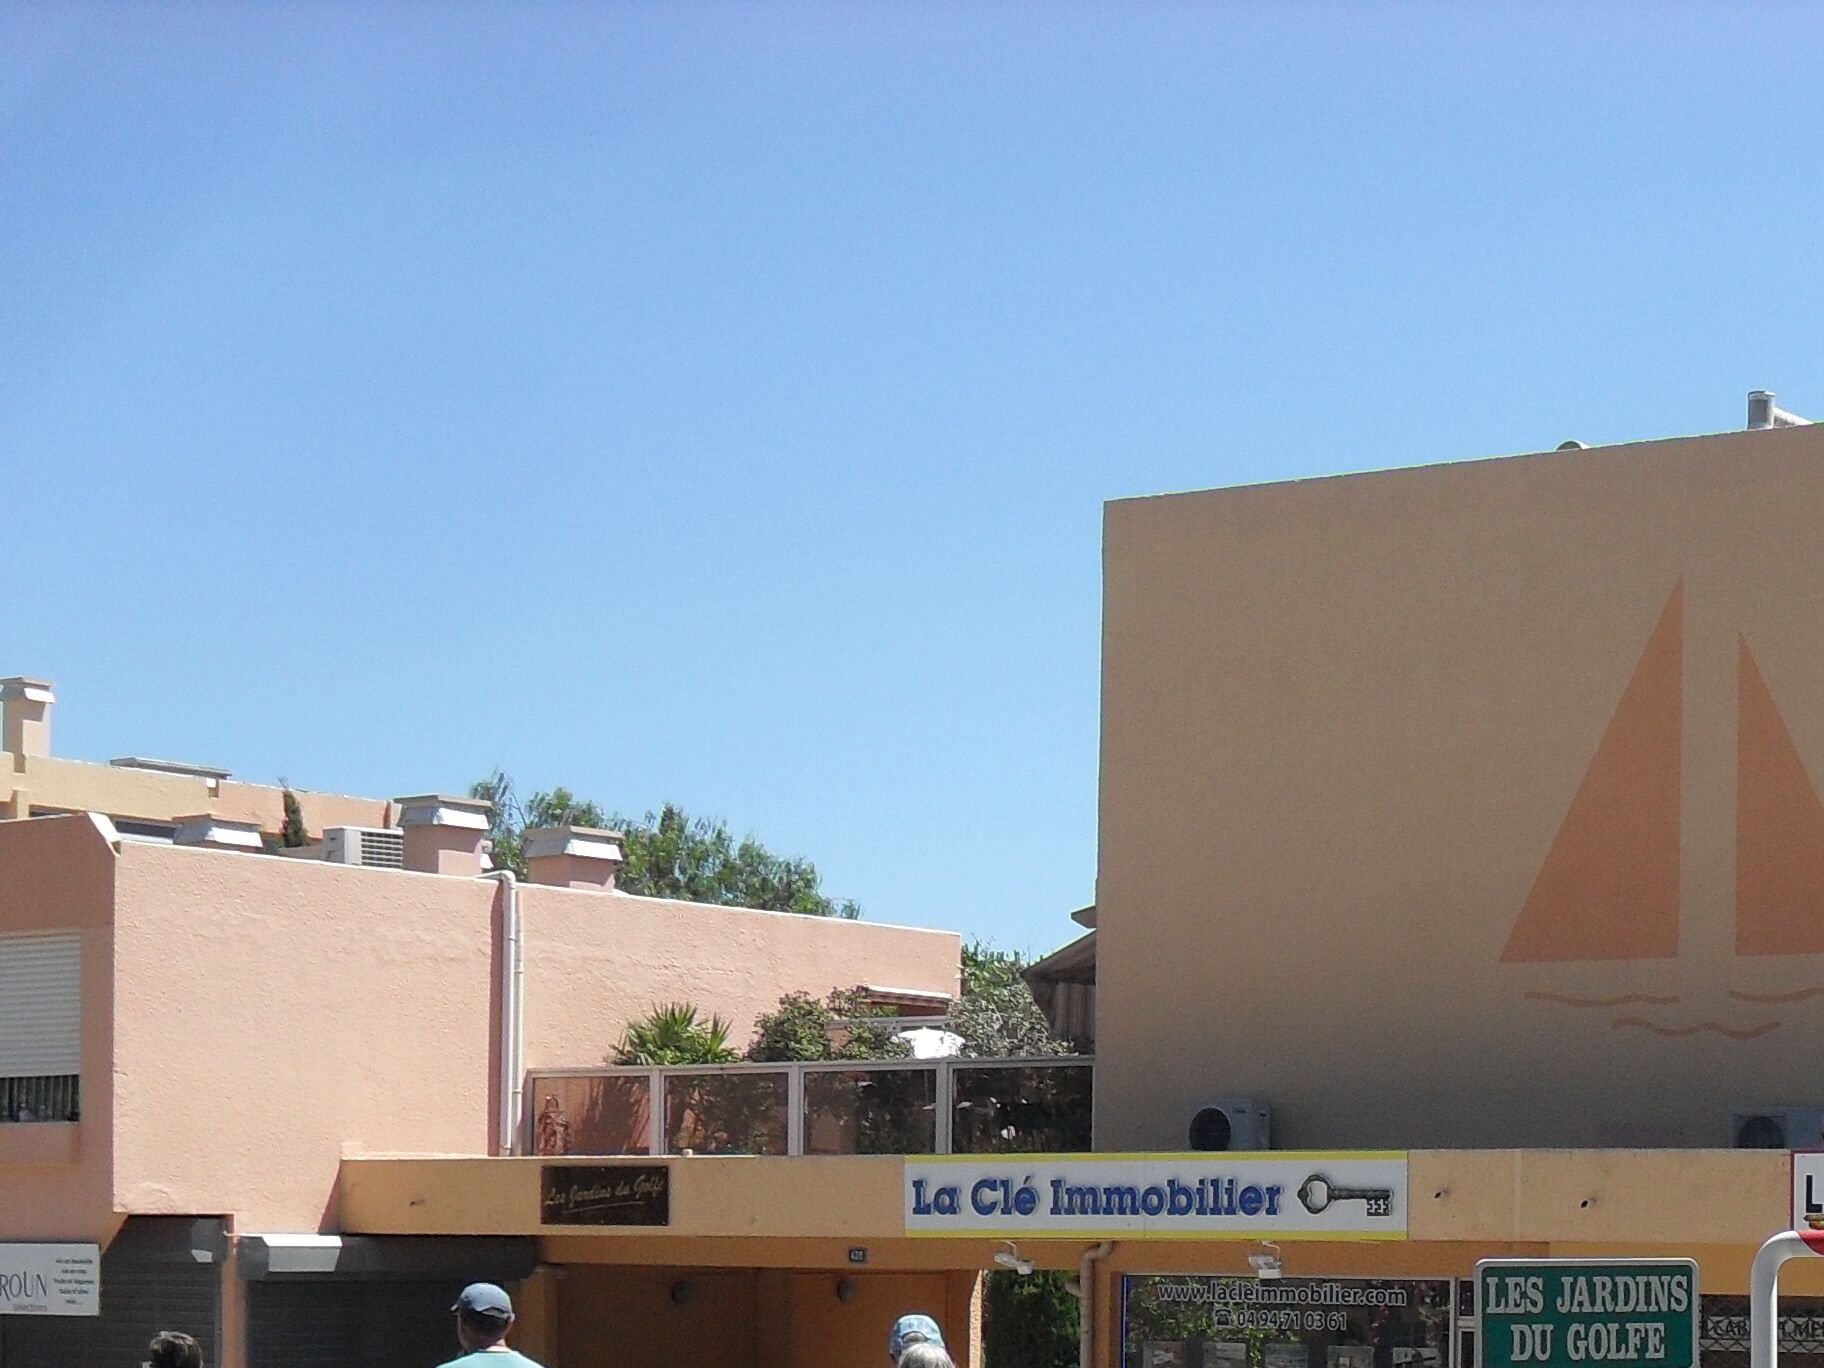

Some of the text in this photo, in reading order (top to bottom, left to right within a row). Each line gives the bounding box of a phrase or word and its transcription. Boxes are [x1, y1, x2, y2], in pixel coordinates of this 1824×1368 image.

[911, 1175, 1282, 1217] La Clé Immobilier
[1486, 1274, 1689, 1314] LES JARDINS
[1283, 1311, 1299, 1329] 71
[1303, 1311, 1324, 1330] 03
[1326, 1312, 1348, 1331] 61
[1510, 1322, 1665, 1361] DU GOLFE
